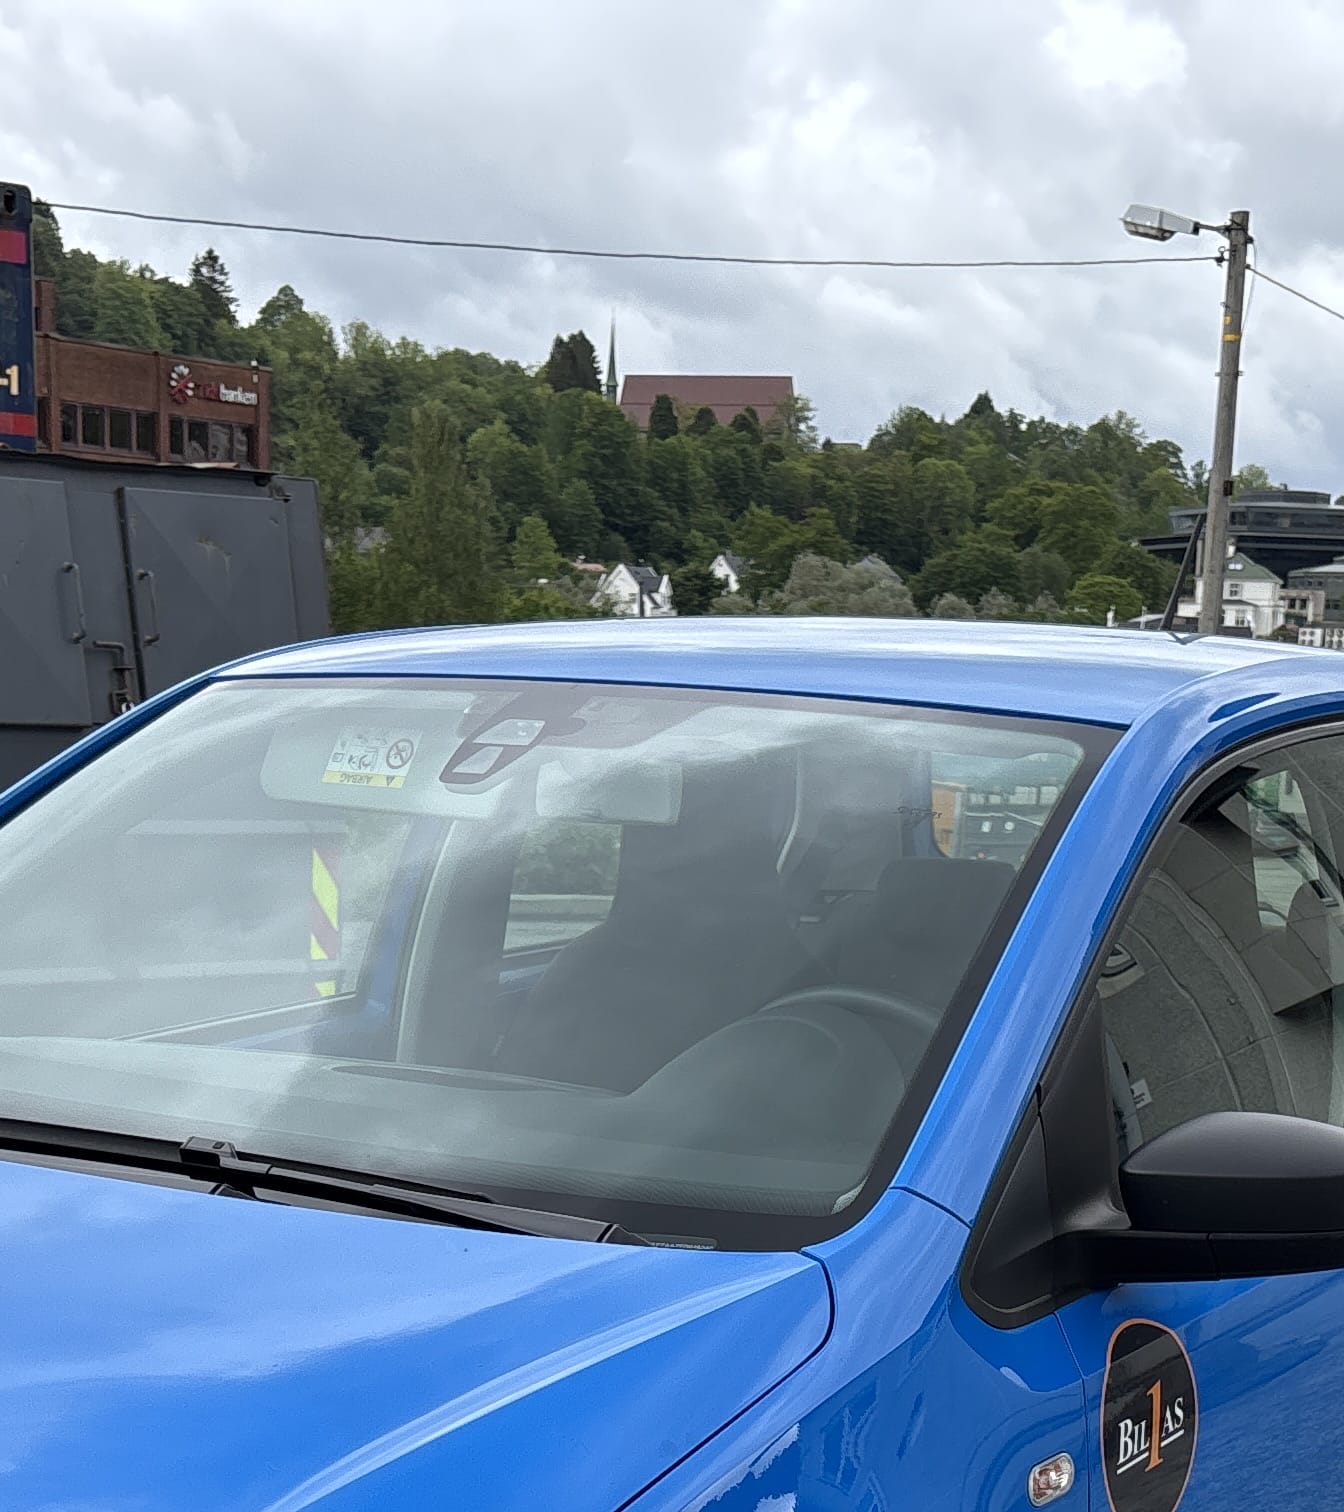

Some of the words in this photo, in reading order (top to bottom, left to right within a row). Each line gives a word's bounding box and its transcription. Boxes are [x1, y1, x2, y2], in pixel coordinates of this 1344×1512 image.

[339, 773, 373, 785] AIRBAG
[1144, 1378, 1164, 1473] 1
[1160, 1397, 1184, 1439] AS
